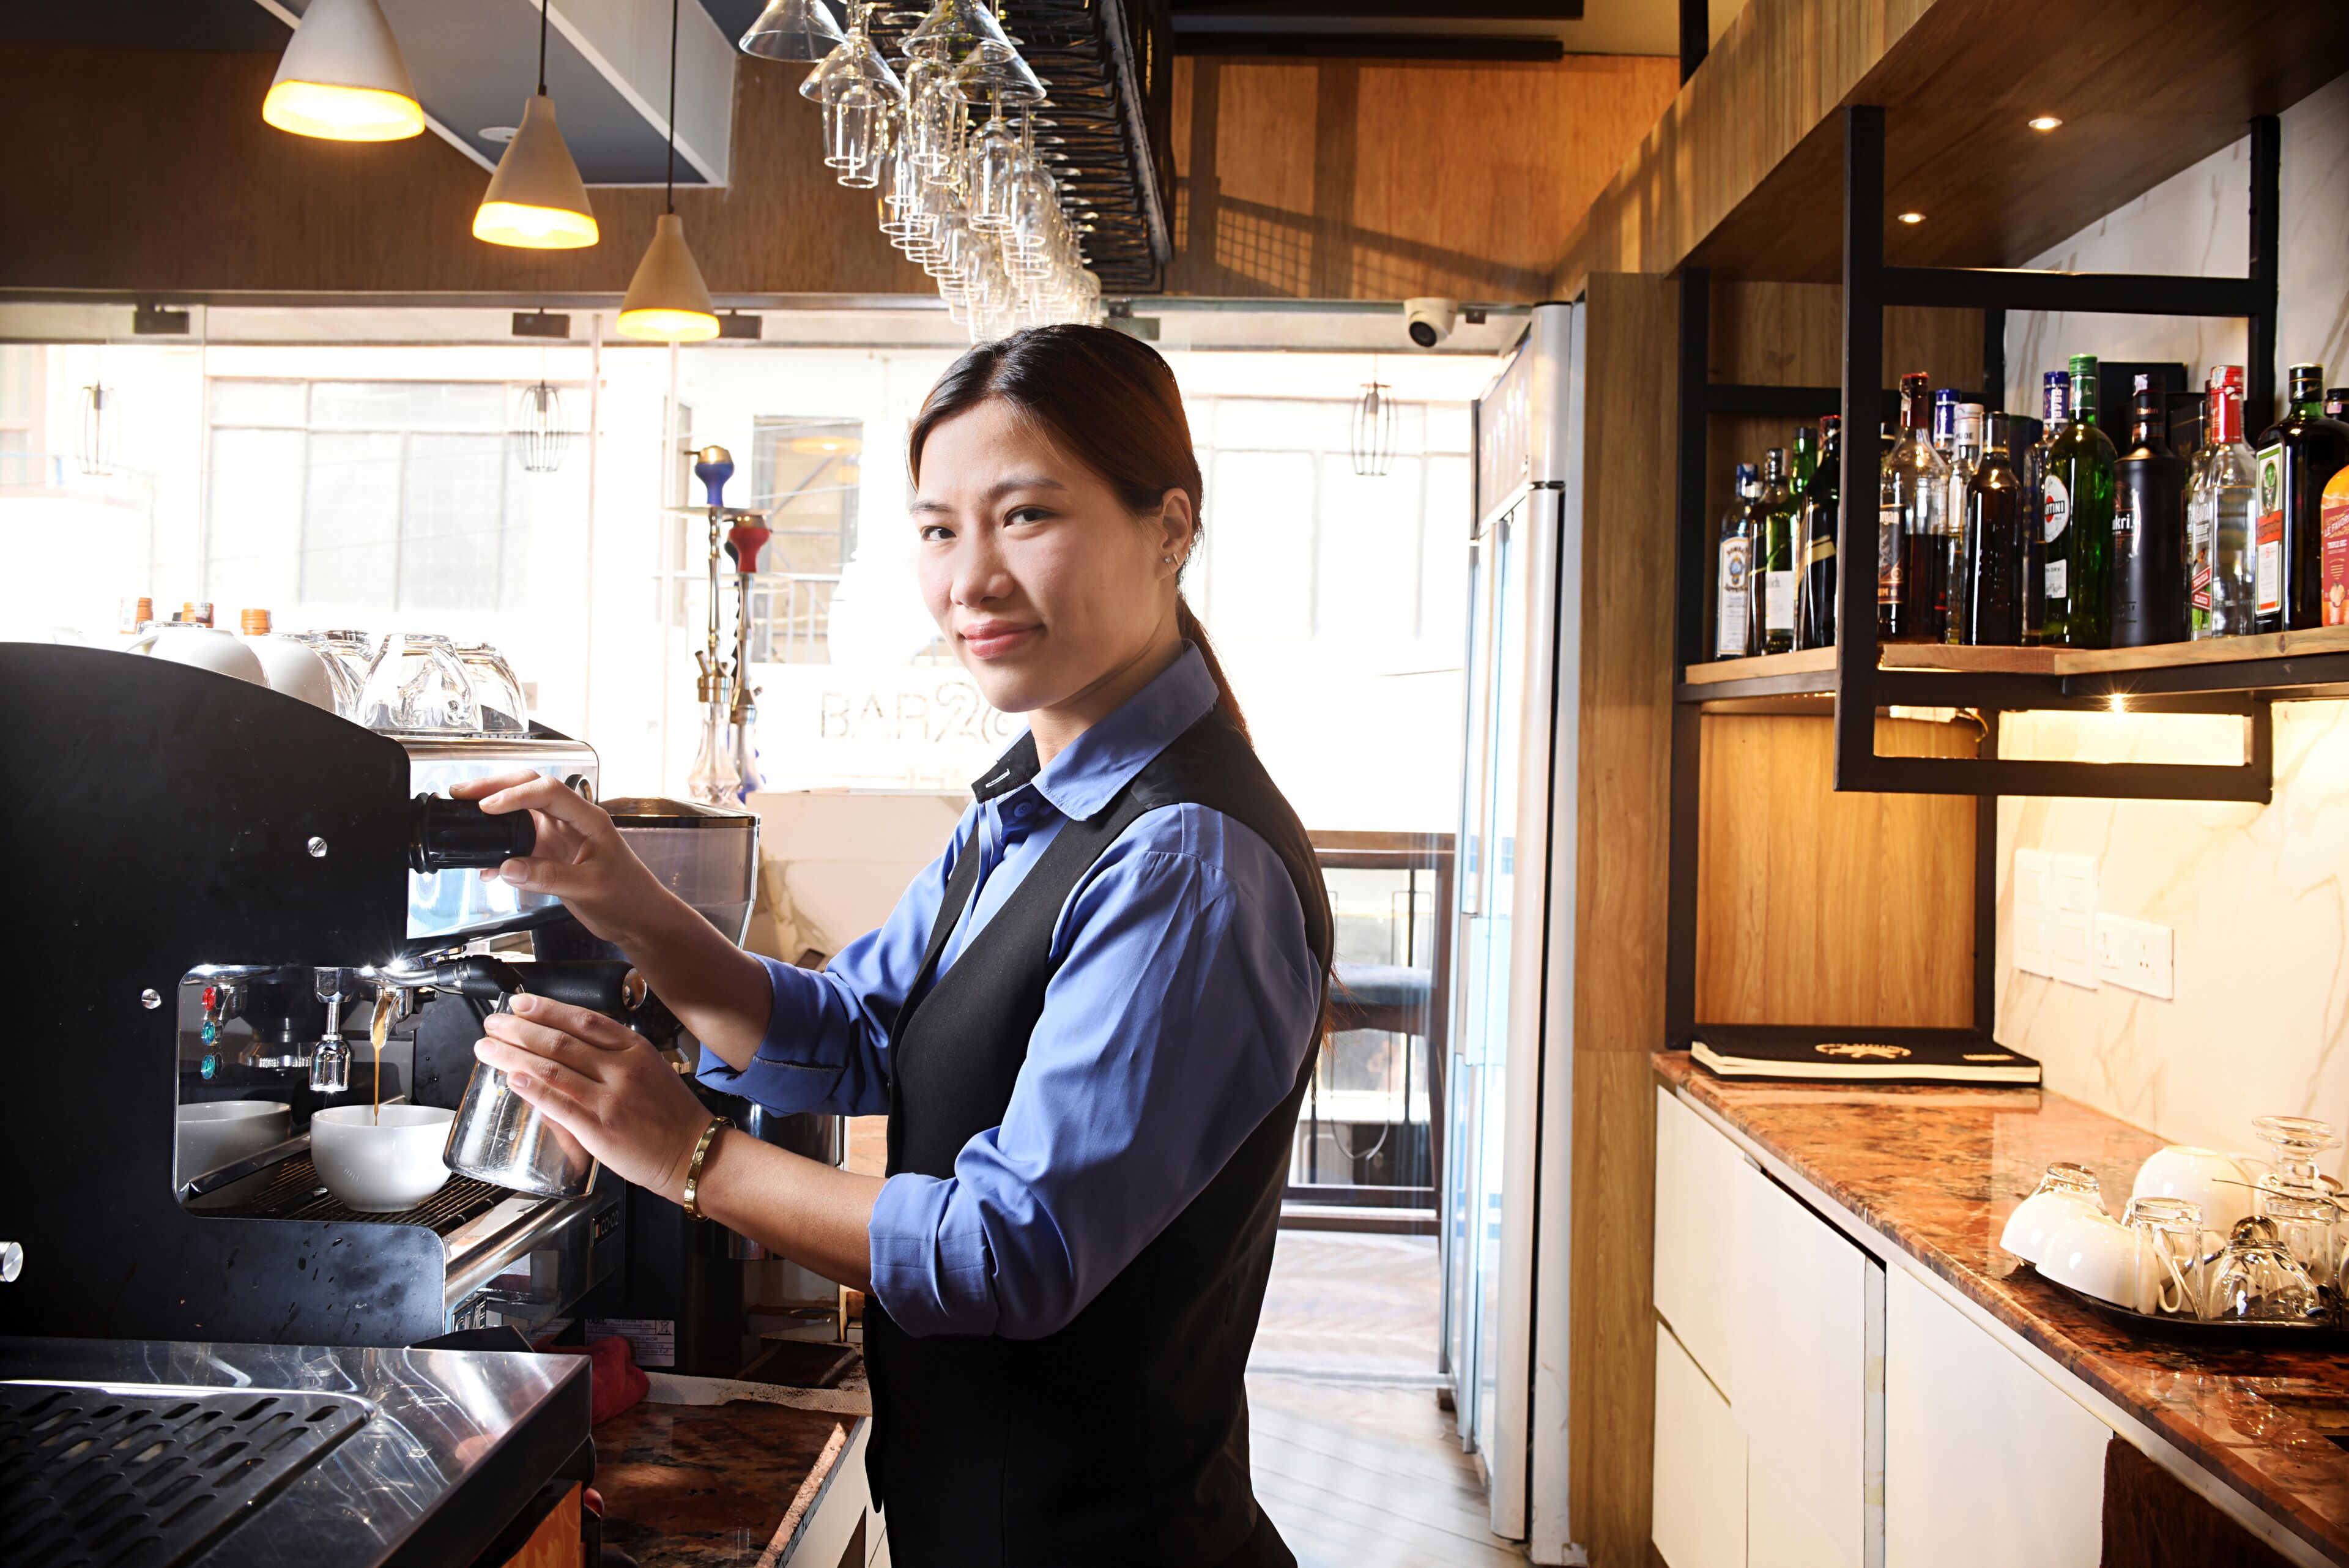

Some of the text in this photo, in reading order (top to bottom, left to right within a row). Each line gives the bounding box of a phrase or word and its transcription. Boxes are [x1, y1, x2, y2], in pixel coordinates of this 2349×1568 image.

[2045, 502, 2064, 515] RTINI
[1880, 511, 1899, 526] rgan
[2112, 514, 2134, 530] ukri.
[1878, 587, 1889, 596] UM
